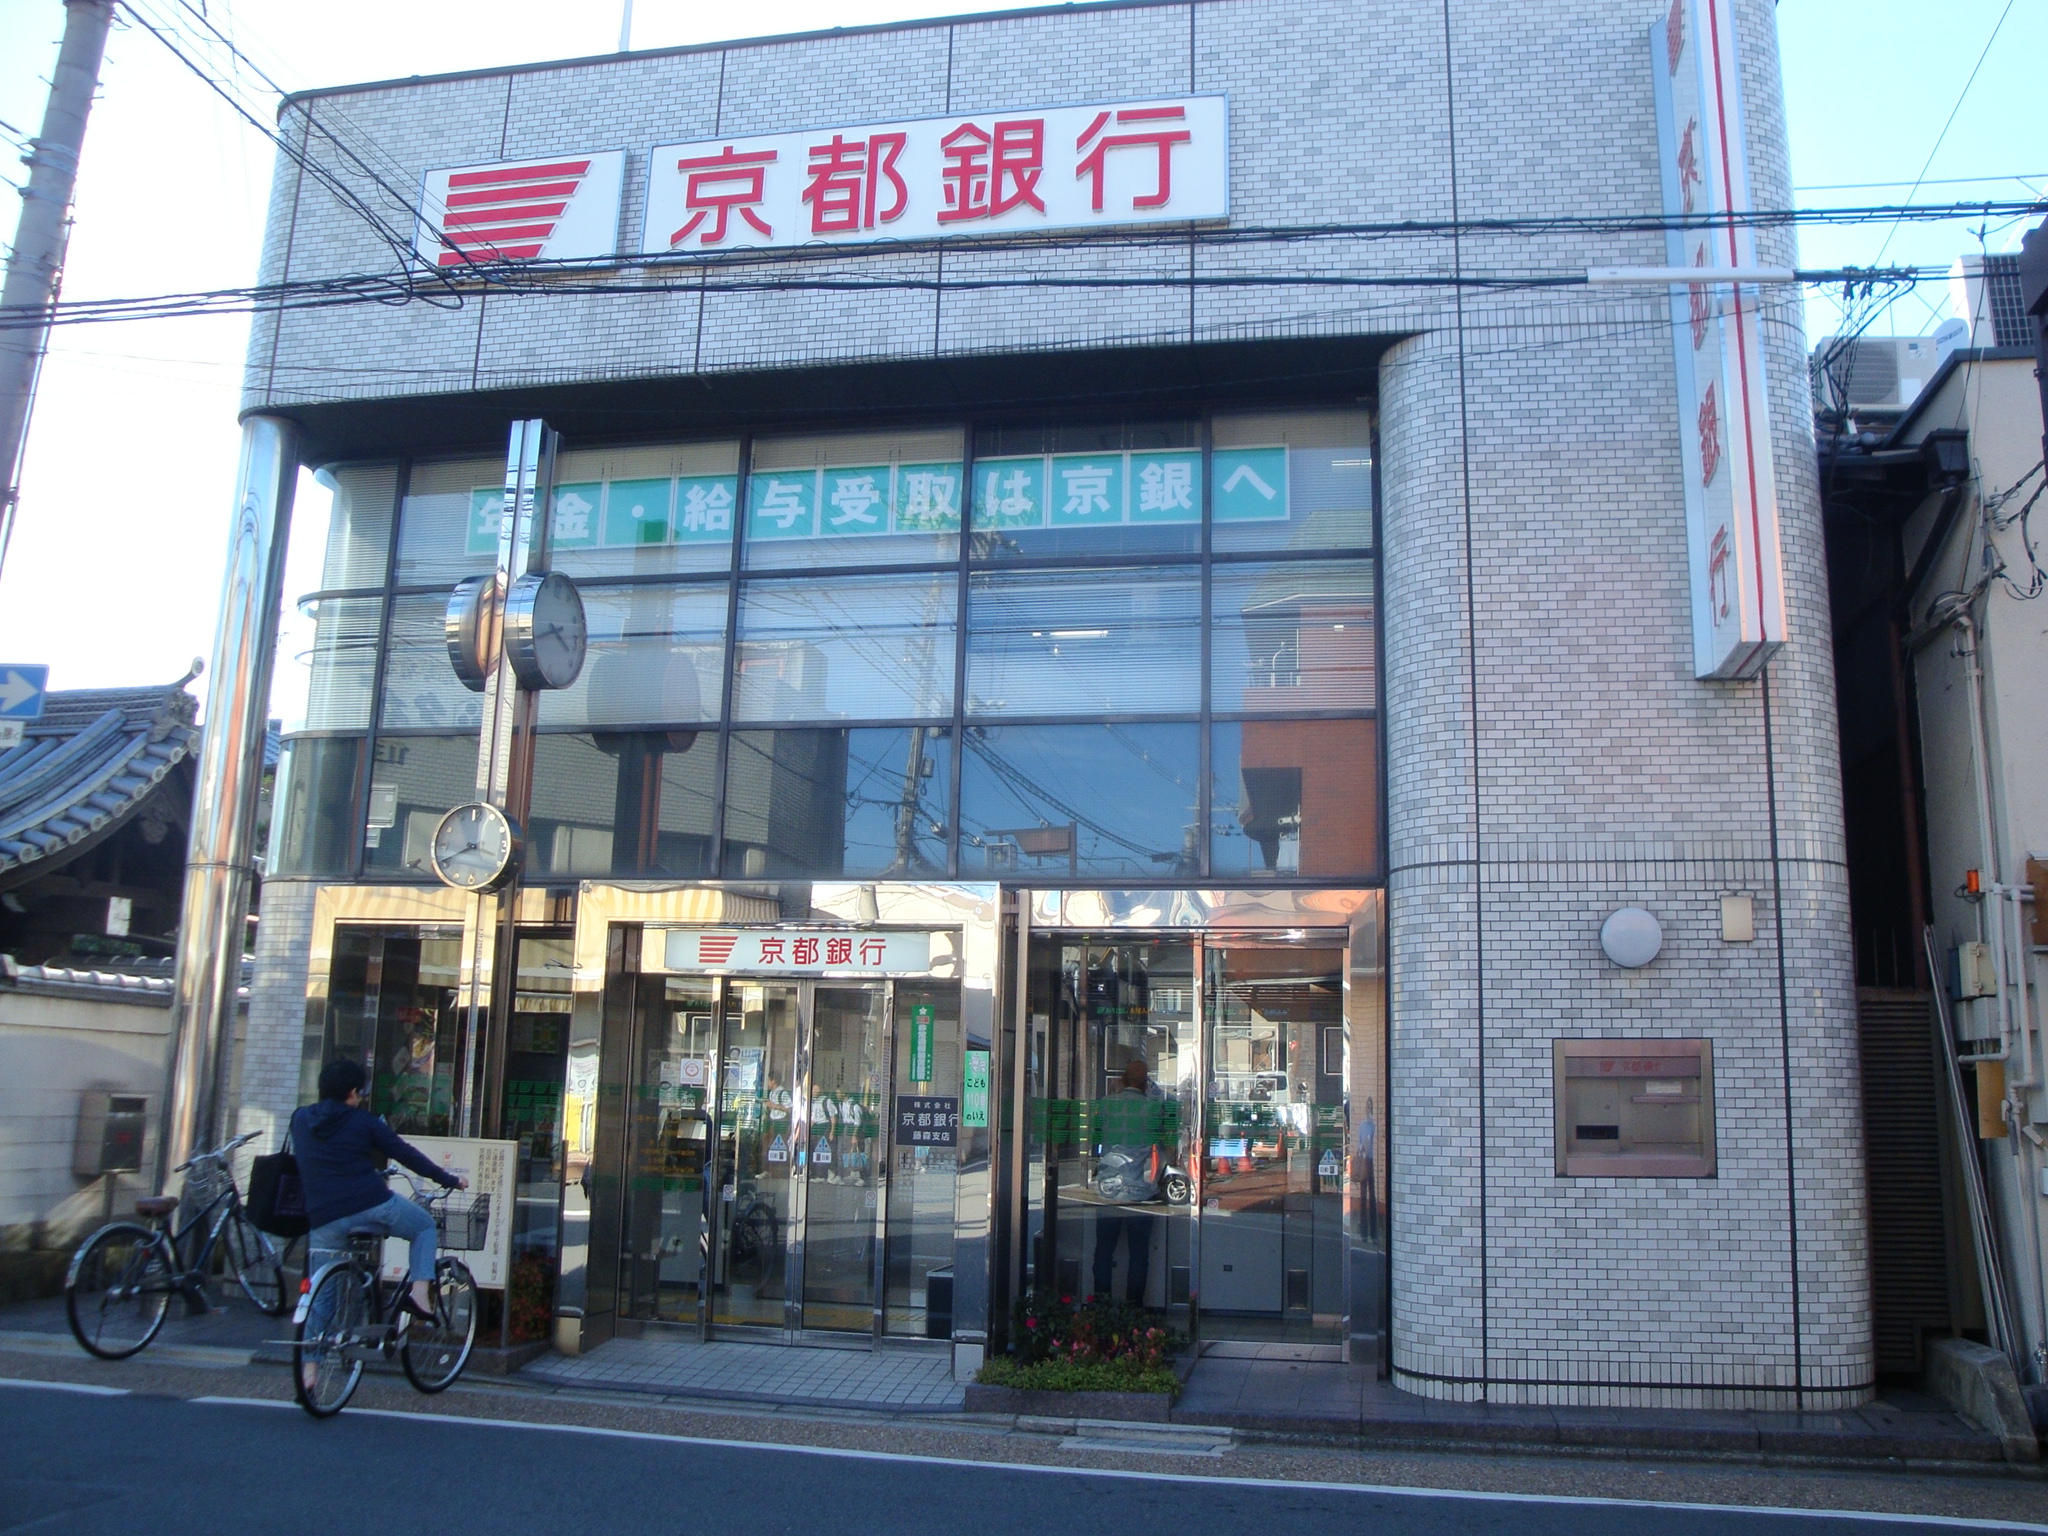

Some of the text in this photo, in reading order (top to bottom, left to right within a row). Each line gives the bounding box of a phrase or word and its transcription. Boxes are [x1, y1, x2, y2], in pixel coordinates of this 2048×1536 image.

[670, 106, 1192, 246] 京都銀行
[1678, 114, 1731, 628] 京都銀行
[758, 936, 887, 966] 京都銀行
[966, 1078, 986, 1088] こども
[913, 1101, 951, 1109] 株式会社
[966, 1093, 986, 1109] 110番
[902, 1112, 959, 1127] 京都銀行
[966, 1110, 985, 1121] のいえ
[912, 1130, 950, 1141] 藤森支店
